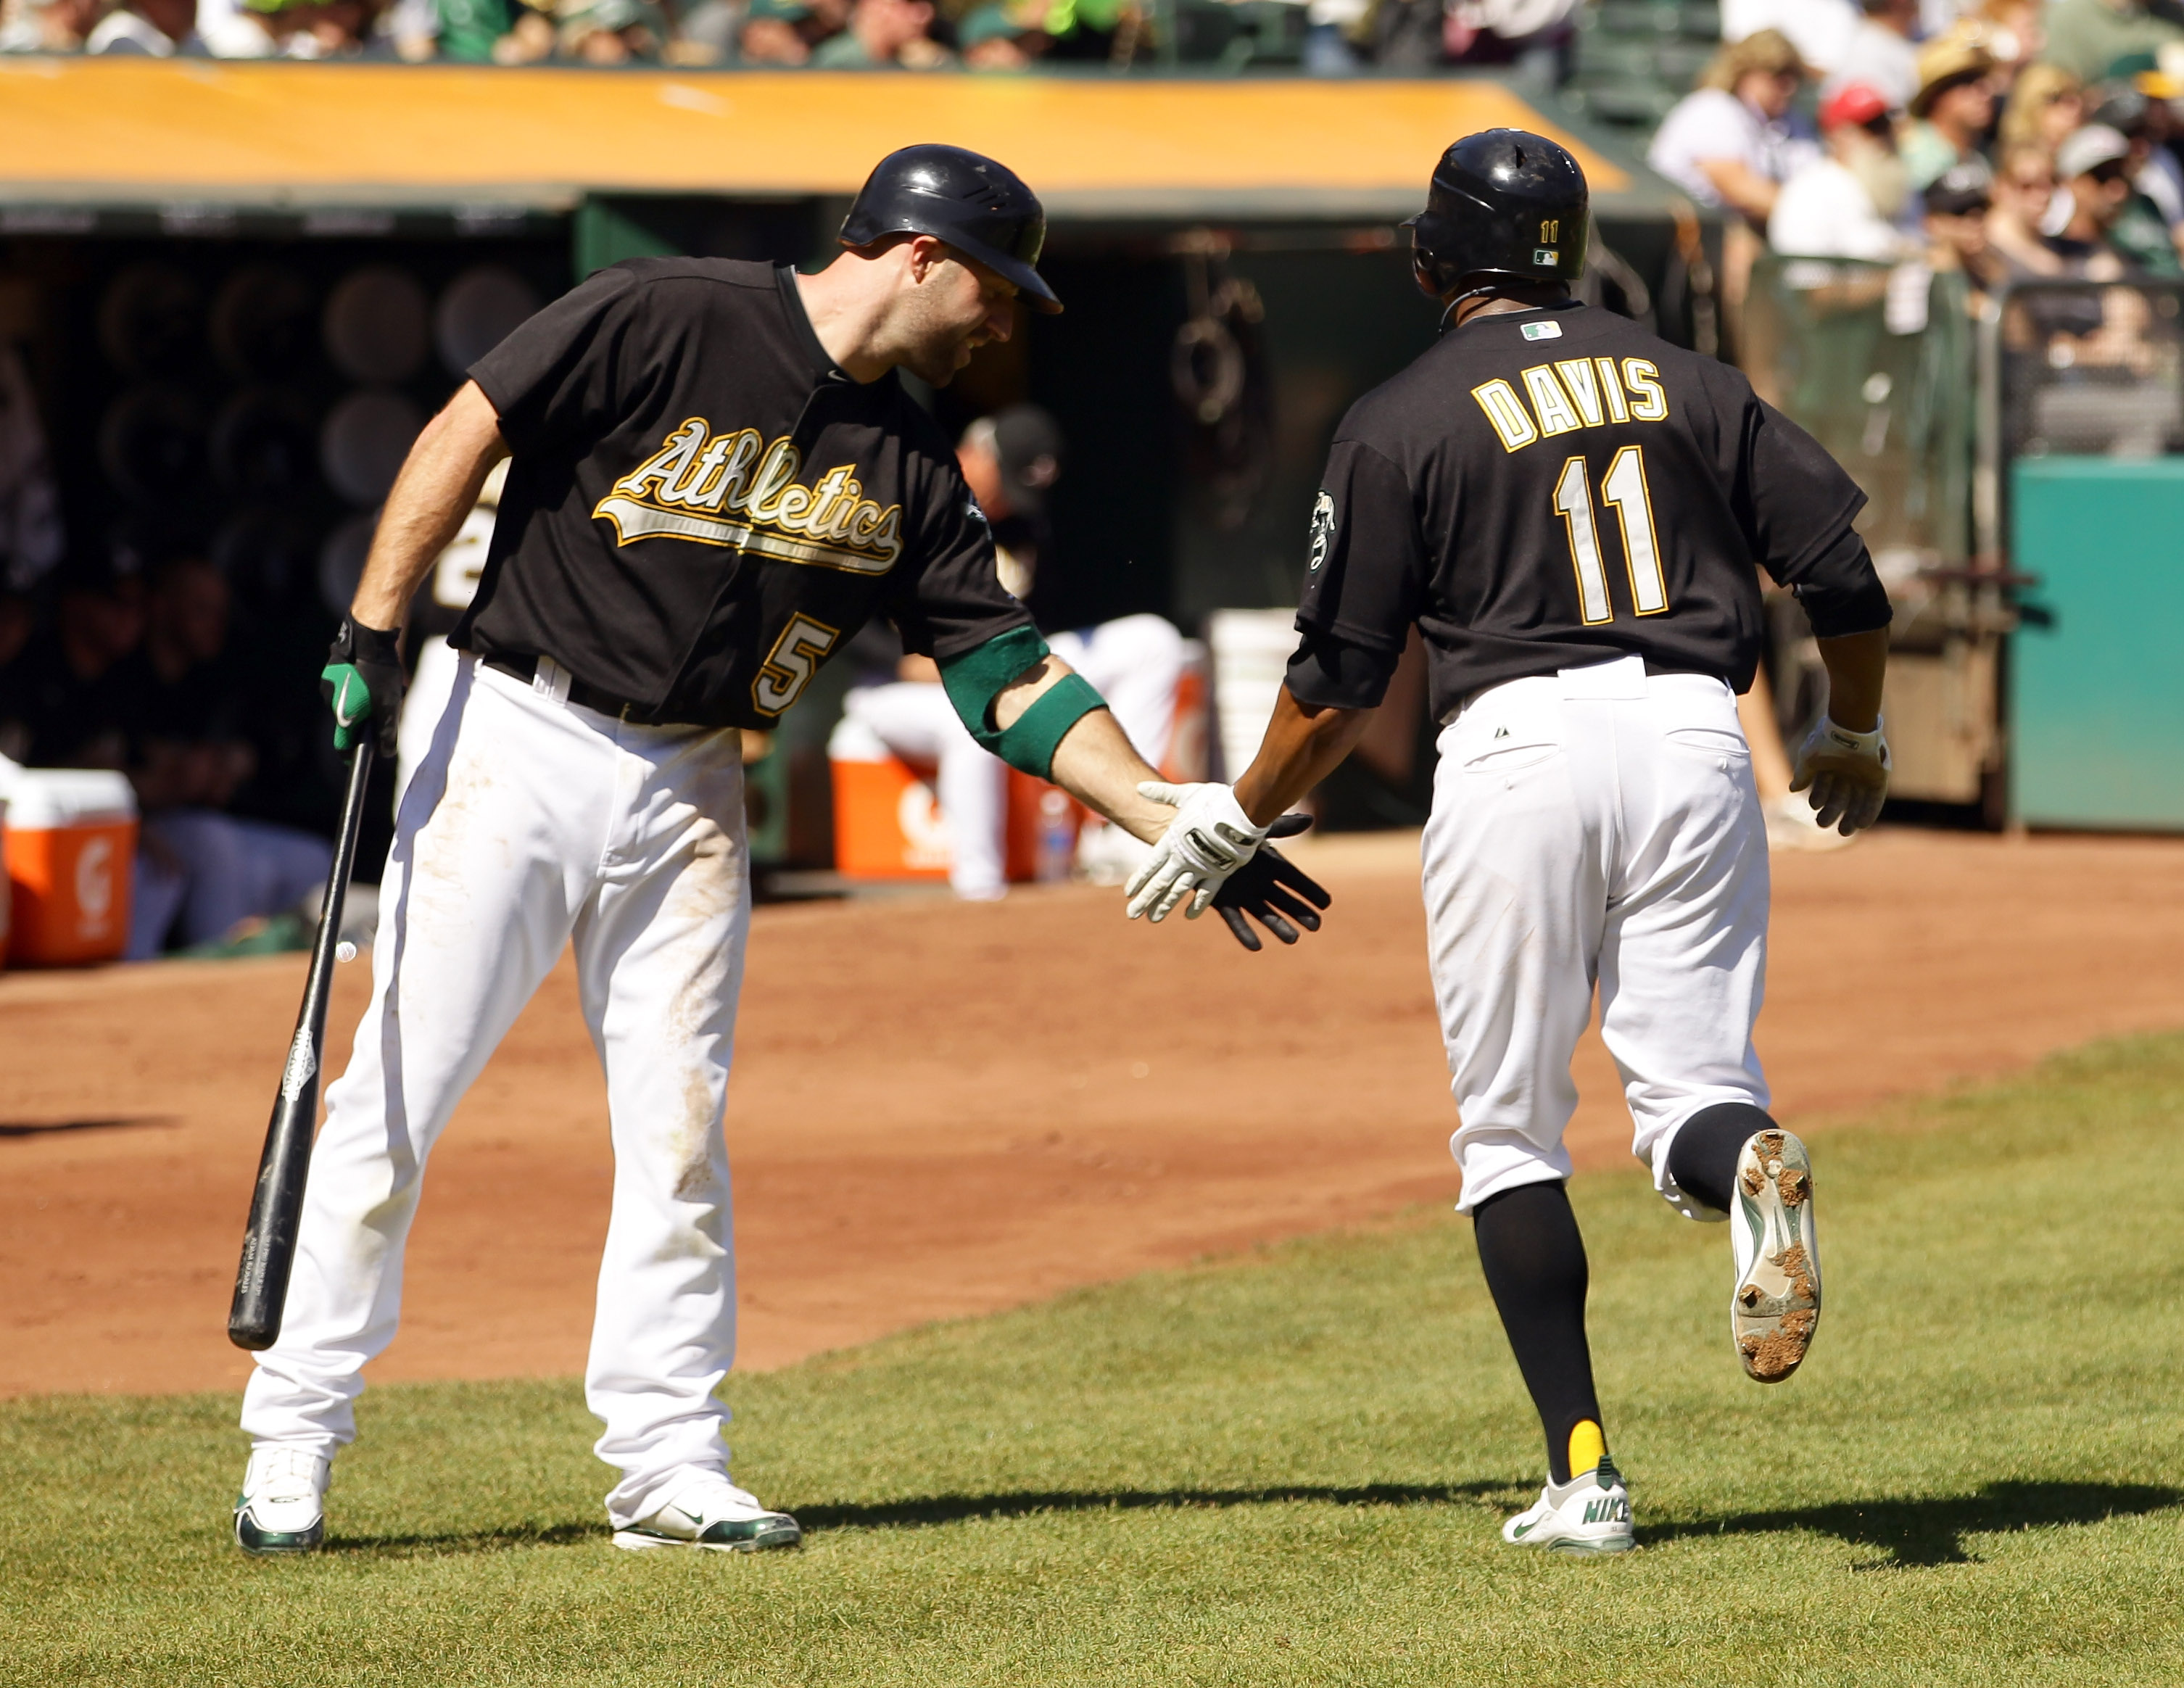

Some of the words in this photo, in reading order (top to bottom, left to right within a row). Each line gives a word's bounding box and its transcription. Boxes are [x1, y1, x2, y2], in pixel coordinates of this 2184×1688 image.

[1540, 220, 1559, 244] 11
[1471, 357, 1669, 453] DAVIS
[610, 415, 903, 554] Athletics
[1552, 444, 1668, 626] 11
[750, 611, 841, 717] 5
[1581, 1498, 1629, 1525] NIKE
